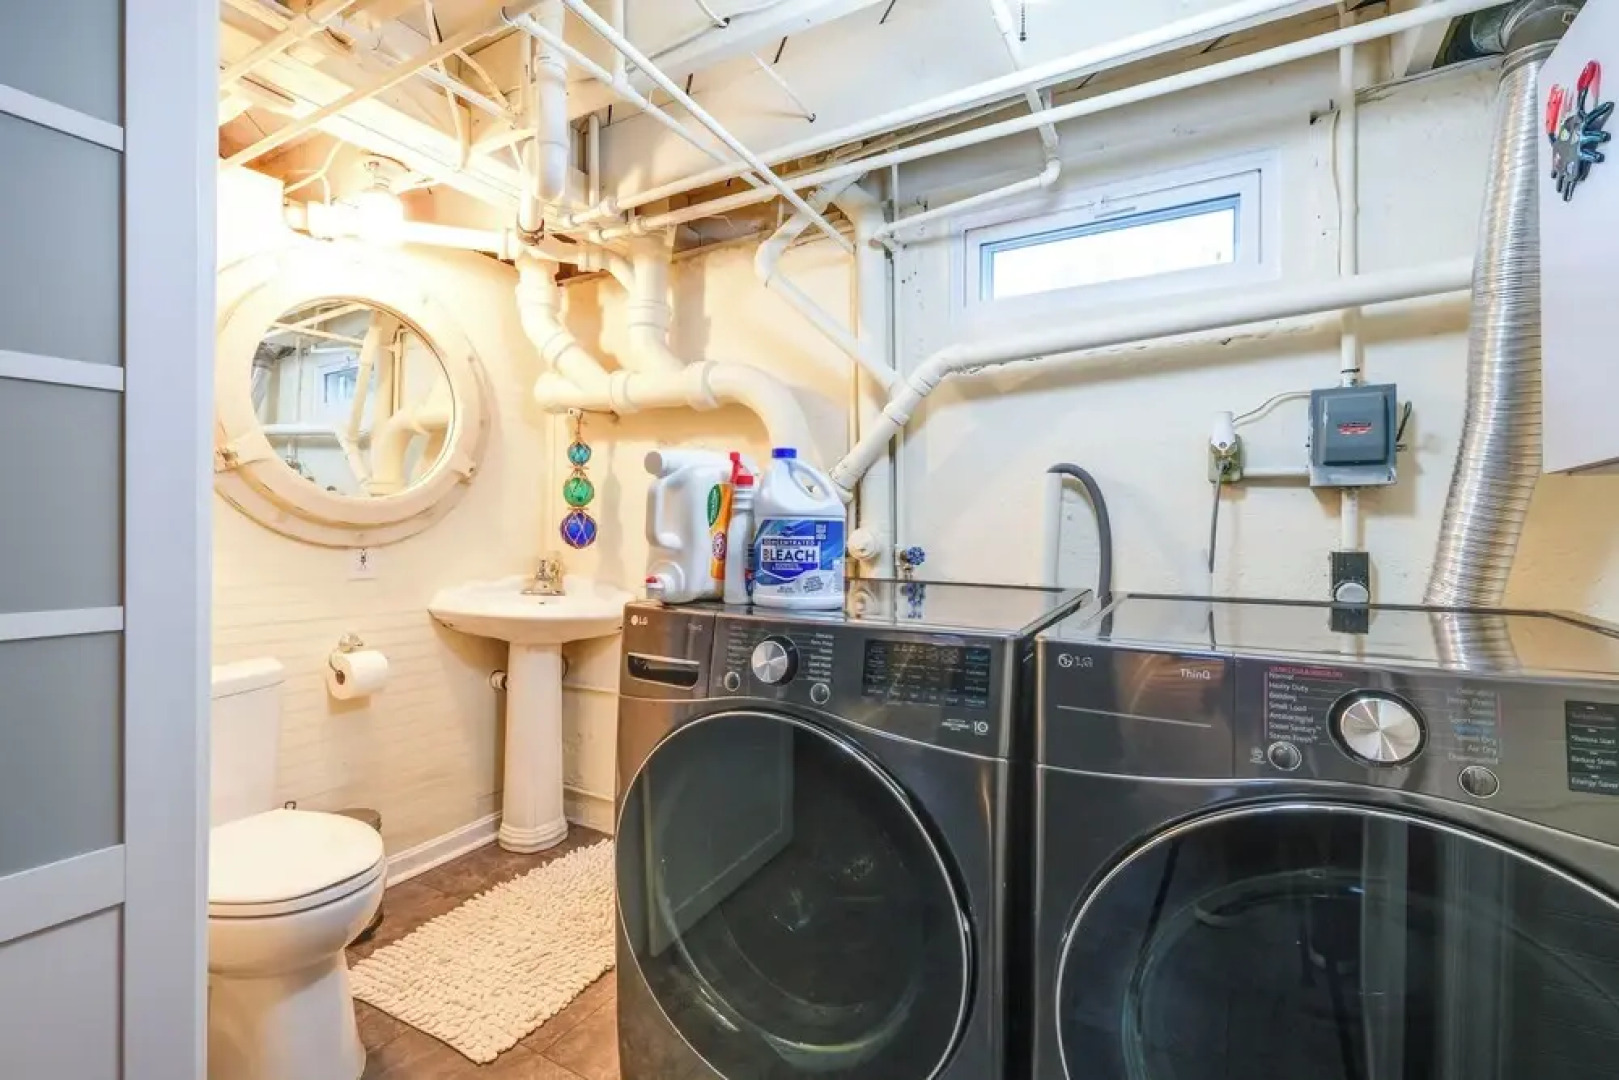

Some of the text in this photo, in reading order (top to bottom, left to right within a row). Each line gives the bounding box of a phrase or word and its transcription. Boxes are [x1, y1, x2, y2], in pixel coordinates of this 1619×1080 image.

[763, 548, 815, 562] BLEACH
[639, 616, 648, 625] LG
[1180, 668, 1211, 680] ThinQ
[1269, 681, 1308, 693] Heavy Duty
